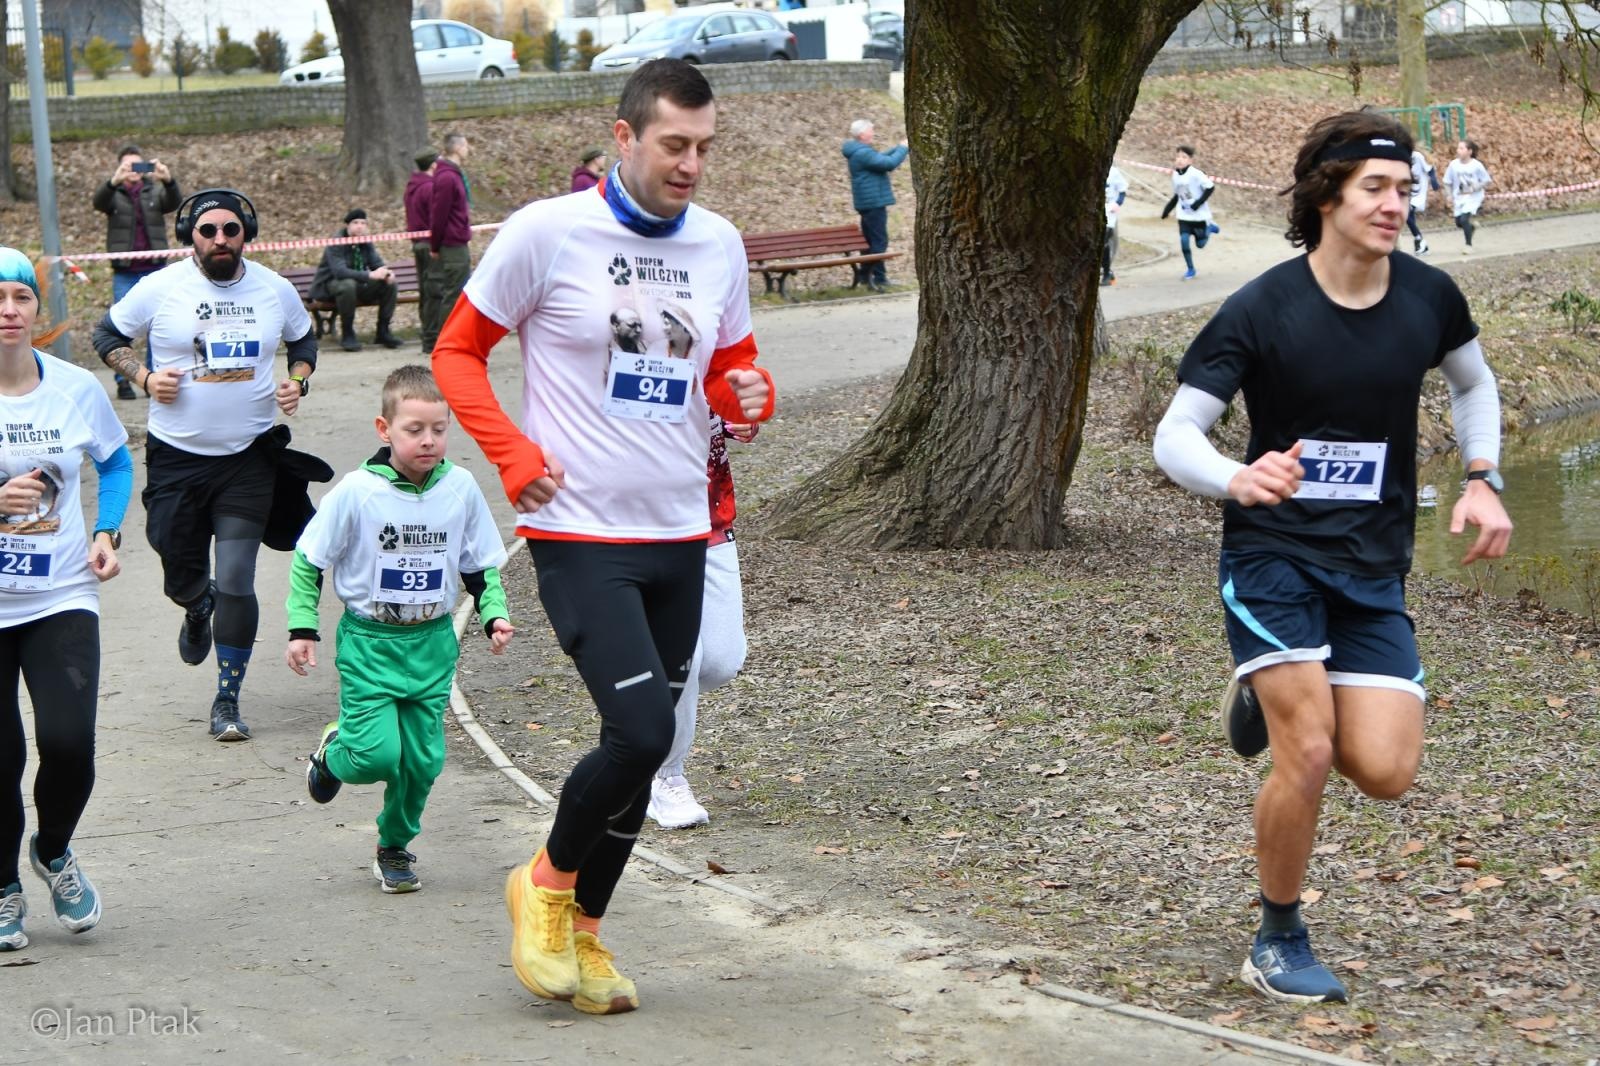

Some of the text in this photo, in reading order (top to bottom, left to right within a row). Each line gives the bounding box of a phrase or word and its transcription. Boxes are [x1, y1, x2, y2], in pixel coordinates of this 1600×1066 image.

[635, 256, 664, 267] TROPEM
[636, 267, 689, 284] WILCZYM
[675, 291, 692, 299] 2026
[215, 306, 255, 315] WILCZYM
[226, 341, 246, 357] 71
[638, 377, 669, 402] 94
[5, 423, 33, 431] TROPEM
[7, 428, 61, 444] WILCZYM
[47, 446, 64, 454] 2026
[1315, 460, 1364, 483] 127
[402, 524, 427, 532] TROPEM
[402, 532, 447, 545] WILCZYM
[2, 553, 33, 575] 24
[402, 571, 429, 590] 93
